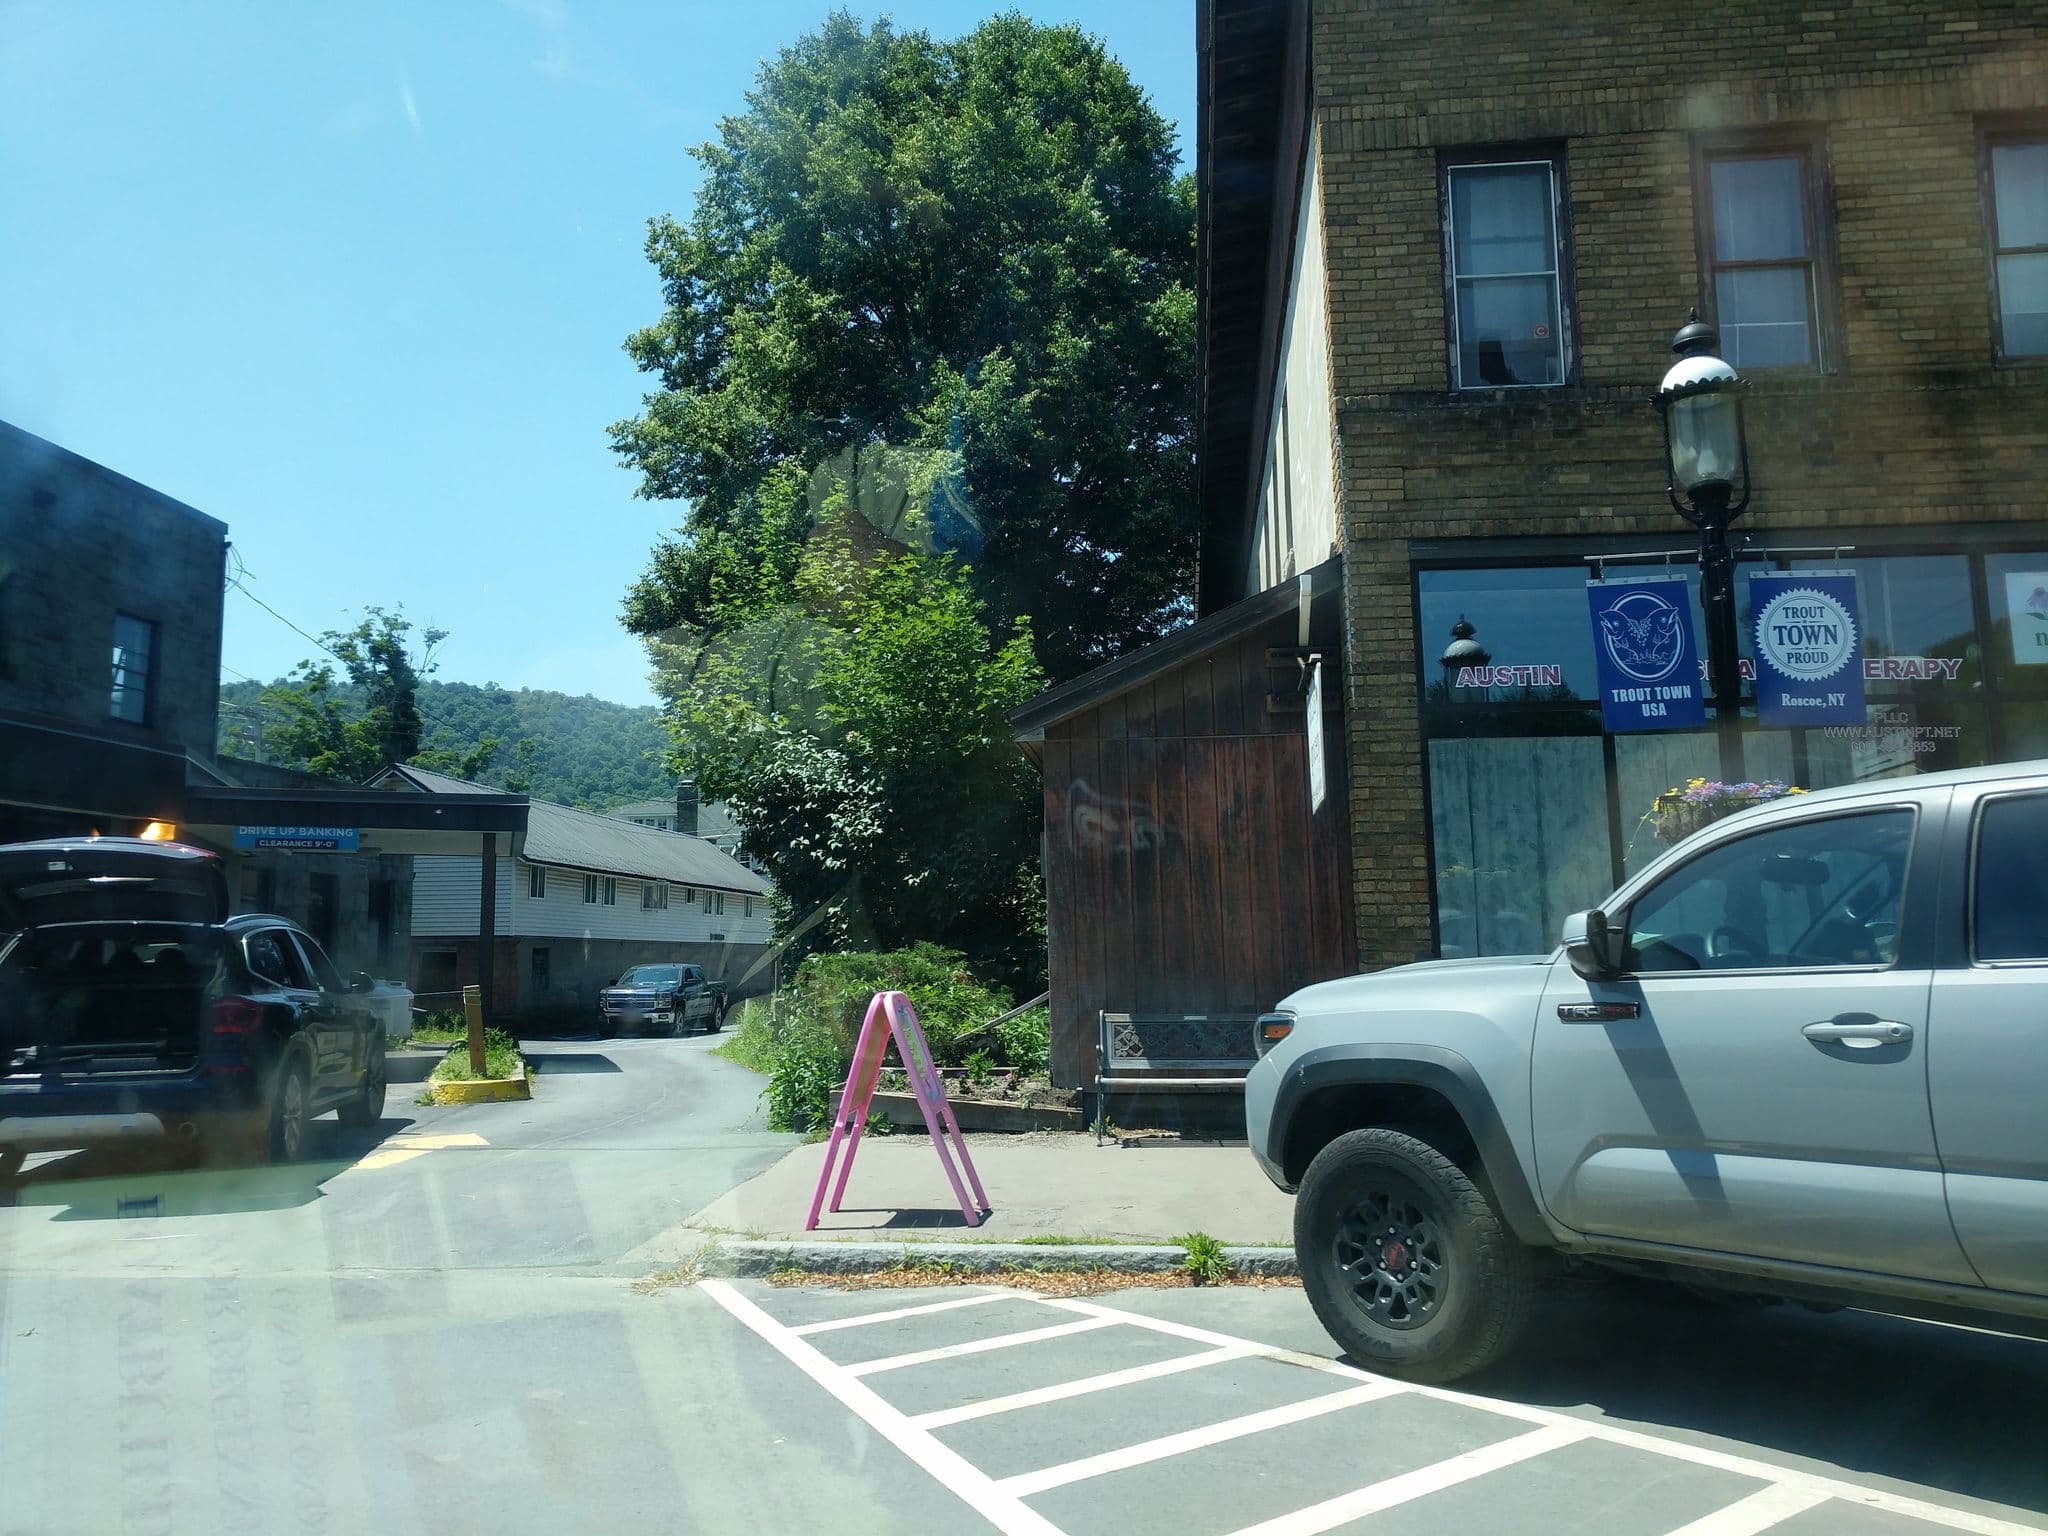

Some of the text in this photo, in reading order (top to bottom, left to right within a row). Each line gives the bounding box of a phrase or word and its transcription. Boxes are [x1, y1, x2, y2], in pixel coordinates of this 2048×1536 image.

[1782, 606, 1825, 619] TROUT
[1773, 624, 1839, 646] TOWN
[1786, 652, 1829, 664] PROUD
[1455, 658, 1963, 688] AUSTIN ERAPY
[1611, 685, 1692, 703] TROUT TOWN
[1781, 693, 1847, 709] Roscoe, NY
[1642, 703, 1668, 717] USA
[1874, 712, 1909, 723] PLLC
[239, 826, 354, 837] DRIVE UP BANKING
[259, 839, 313, 848] CLEARANCE
